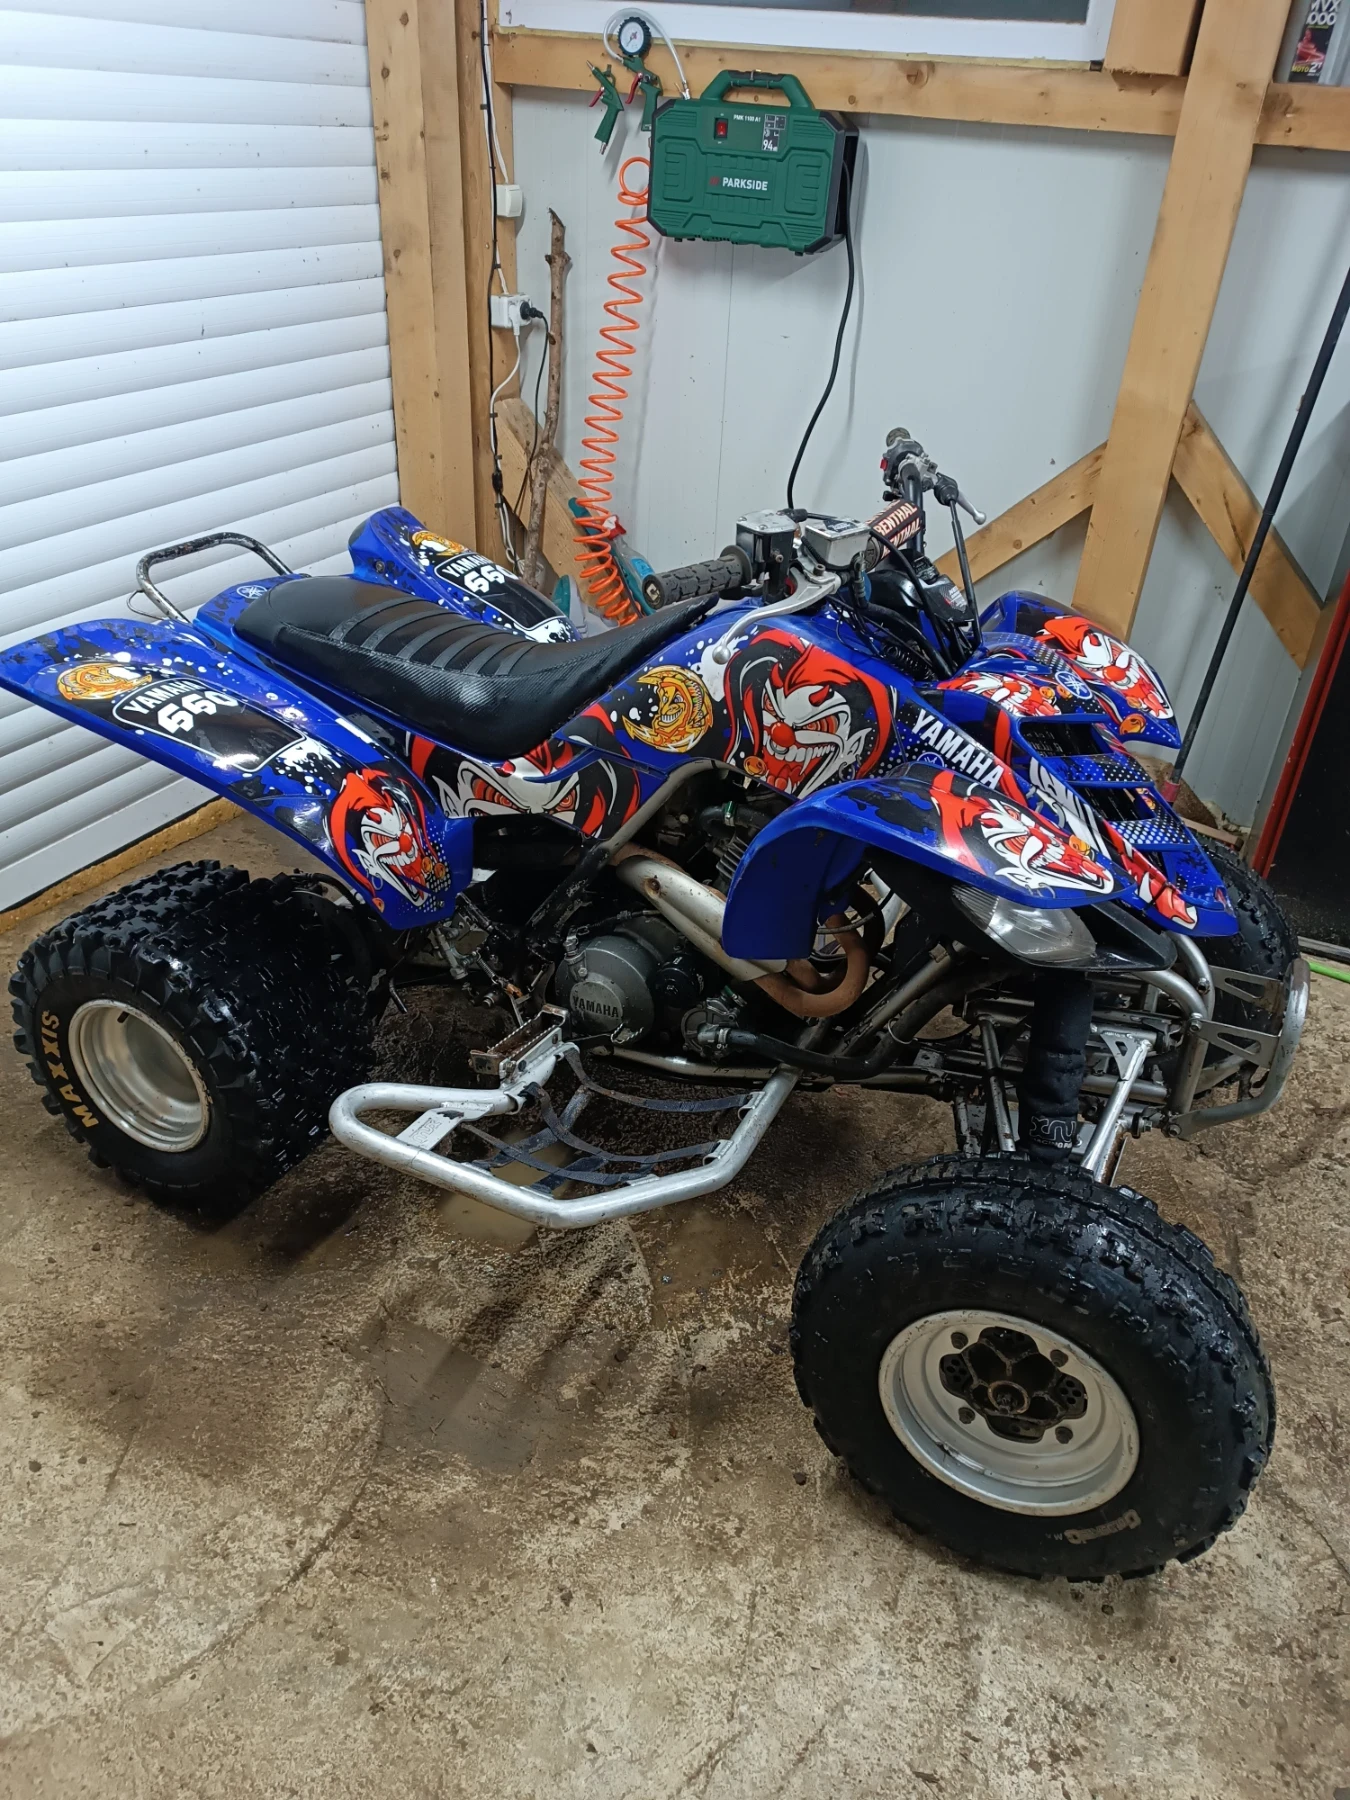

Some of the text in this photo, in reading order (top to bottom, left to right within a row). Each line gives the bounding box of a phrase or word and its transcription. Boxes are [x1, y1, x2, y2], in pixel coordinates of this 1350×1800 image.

[763, 139, 773, 151] 94
[722, 177, 768, 191] PARKSIDE
[873, 503, 918, 536] RENTHAL
[123, 680, 207, 715] YAMAHA
[157, 691, 239, 734] 660
[911, 709, 1005, 790] YAMAHA
[572, 996, 619, 1018] YAMAHA
[42, 1010, 99, 1128] MAXXIS
